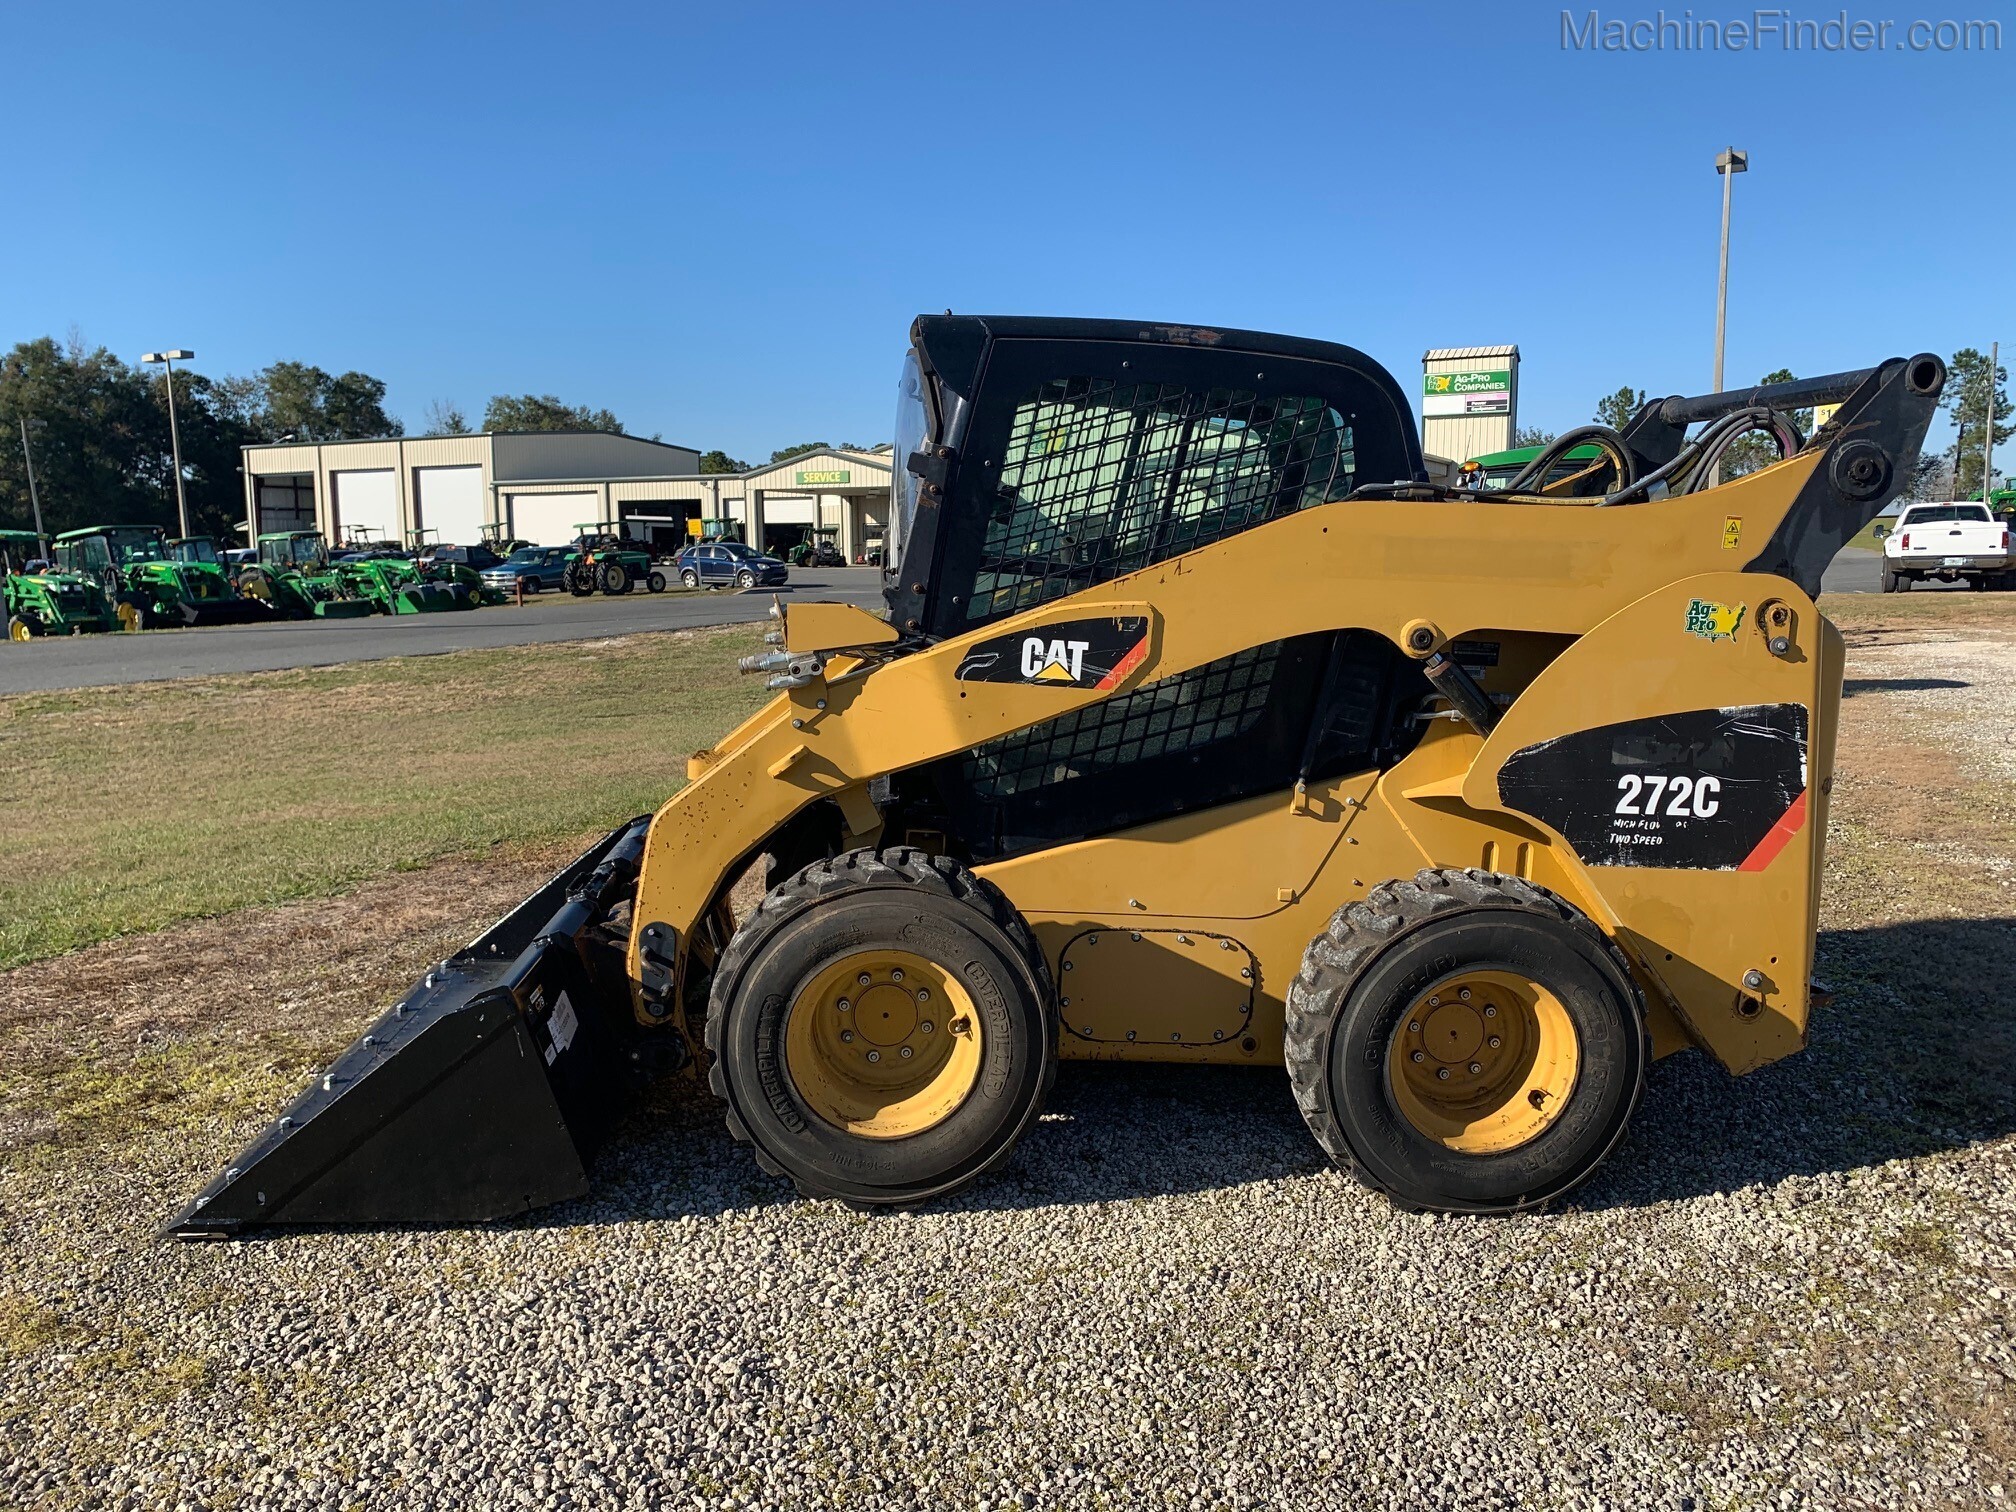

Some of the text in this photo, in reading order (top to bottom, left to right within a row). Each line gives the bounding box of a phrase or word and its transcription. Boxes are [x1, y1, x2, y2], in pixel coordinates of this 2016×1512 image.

[1454, 382, 1505, 392] COMPANIES
[804, 471, 841, 483] SERVICE
[1688, 601, 1717, 618] Ag-
[1686, 616, 1716, 631] Pro
[1021, 637, 1089, 681] CAT
[1615, 774, 1721, 818] 272C
[1609, 833, 1663, 845] TWO SPEED
[968, 965, 1012, 1097] CATERPILLAR
[759, 1000, 806, 1130] CATERPILLAR
